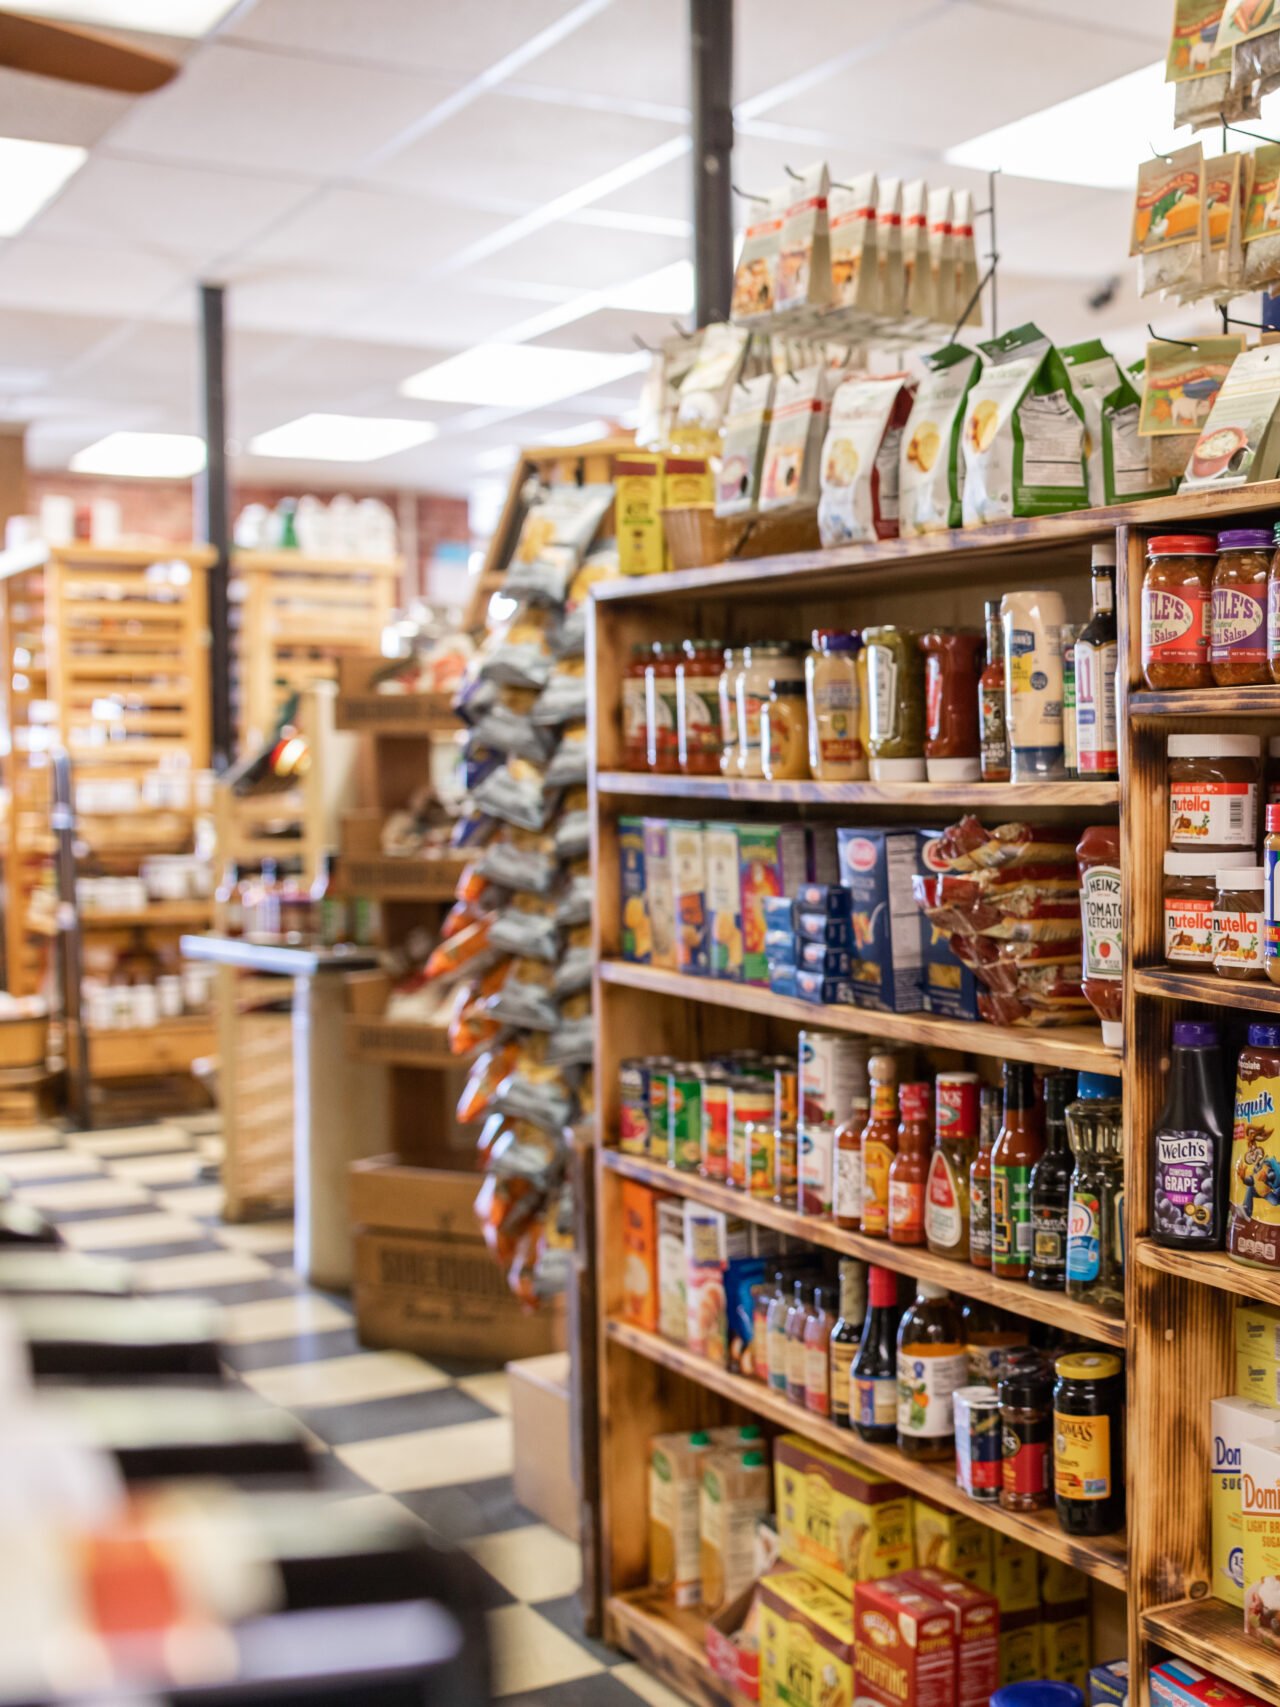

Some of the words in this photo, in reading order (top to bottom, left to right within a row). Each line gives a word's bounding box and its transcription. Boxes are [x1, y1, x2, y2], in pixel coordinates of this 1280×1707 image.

[1155, 628, 1178, 644] Salsa
[1223, 627, 1247, 643] Salsa
[1172, 795, 1210, 812] nutella
[1089, 878, 1121, 895] HEINZ
[1168, 912, 1213, 930] nutella
[1213, 911, 1258, 934] nutella
[1160, 1141, 1206, 1160] Welch's
[1164, 1176, 1199, 1194] GRAPE
[1247, 1519, 1266, 1533] LIGHT
